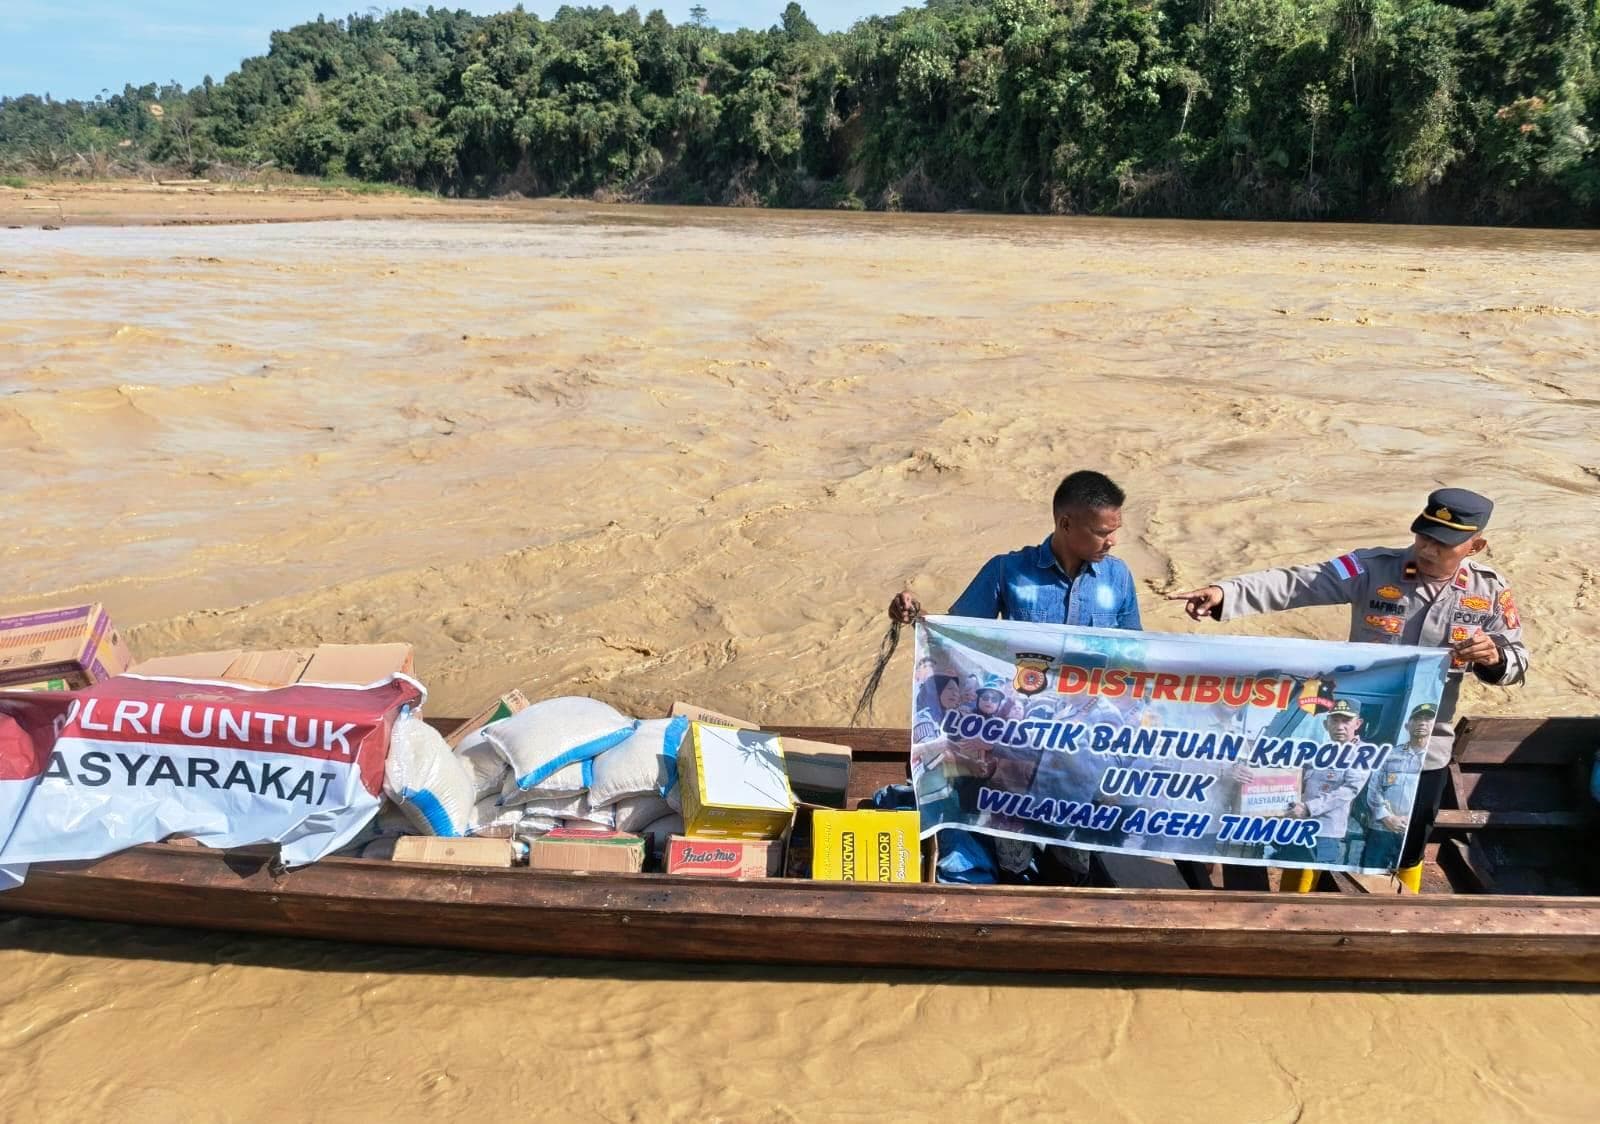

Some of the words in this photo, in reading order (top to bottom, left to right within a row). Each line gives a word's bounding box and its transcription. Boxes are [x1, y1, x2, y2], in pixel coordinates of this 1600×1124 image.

[1057, 665, 1292, 709] DISTRIBUSI
[180, 705, 359, 755] UNTUK
[942, 710, 1086, 751] LOGISTIK
[1092, 725, 1246, 763] BANTUAN
[1252, 736, 1390, 772] KAPOLRI
[36, 750, 337, 806] ASYARAKAT
[1101, 768, 1216, 801] UNTUK
[979, 790, 1120, 830] WILAYAH
[1123, 813, 1208, 838] ACEH
[1221, 817, 1322, 847] TIMUR
[879, 834, 890, 881] ADIMOR
